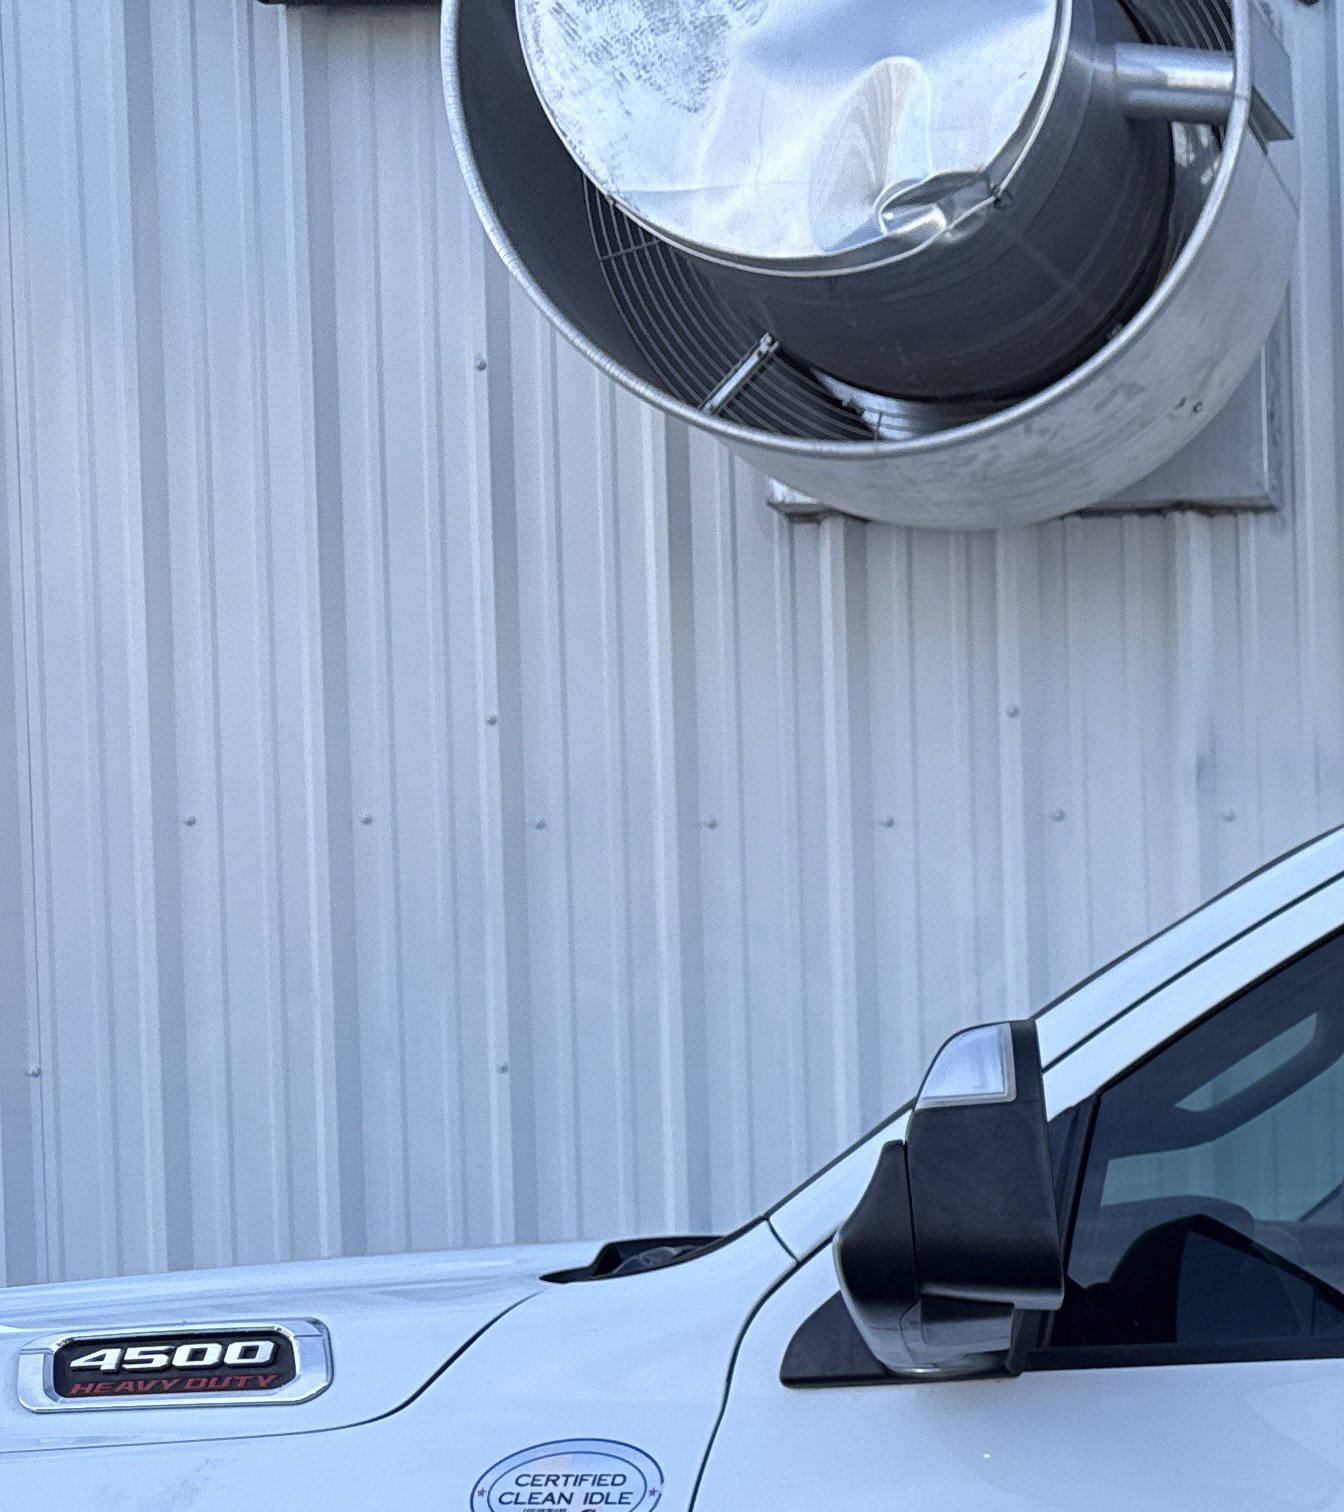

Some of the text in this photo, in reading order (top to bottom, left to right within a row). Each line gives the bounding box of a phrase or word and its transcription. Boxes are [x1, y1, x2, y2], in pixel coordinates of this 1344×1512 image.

[69, 1339, 276, 1371] 4500
[70, 1373, 280, 1396] HEAVY DUTY
[514, 1473, 627, 1487] CERTIFIED
[498, 1491, 633, 1506] CLEAN IDLE
